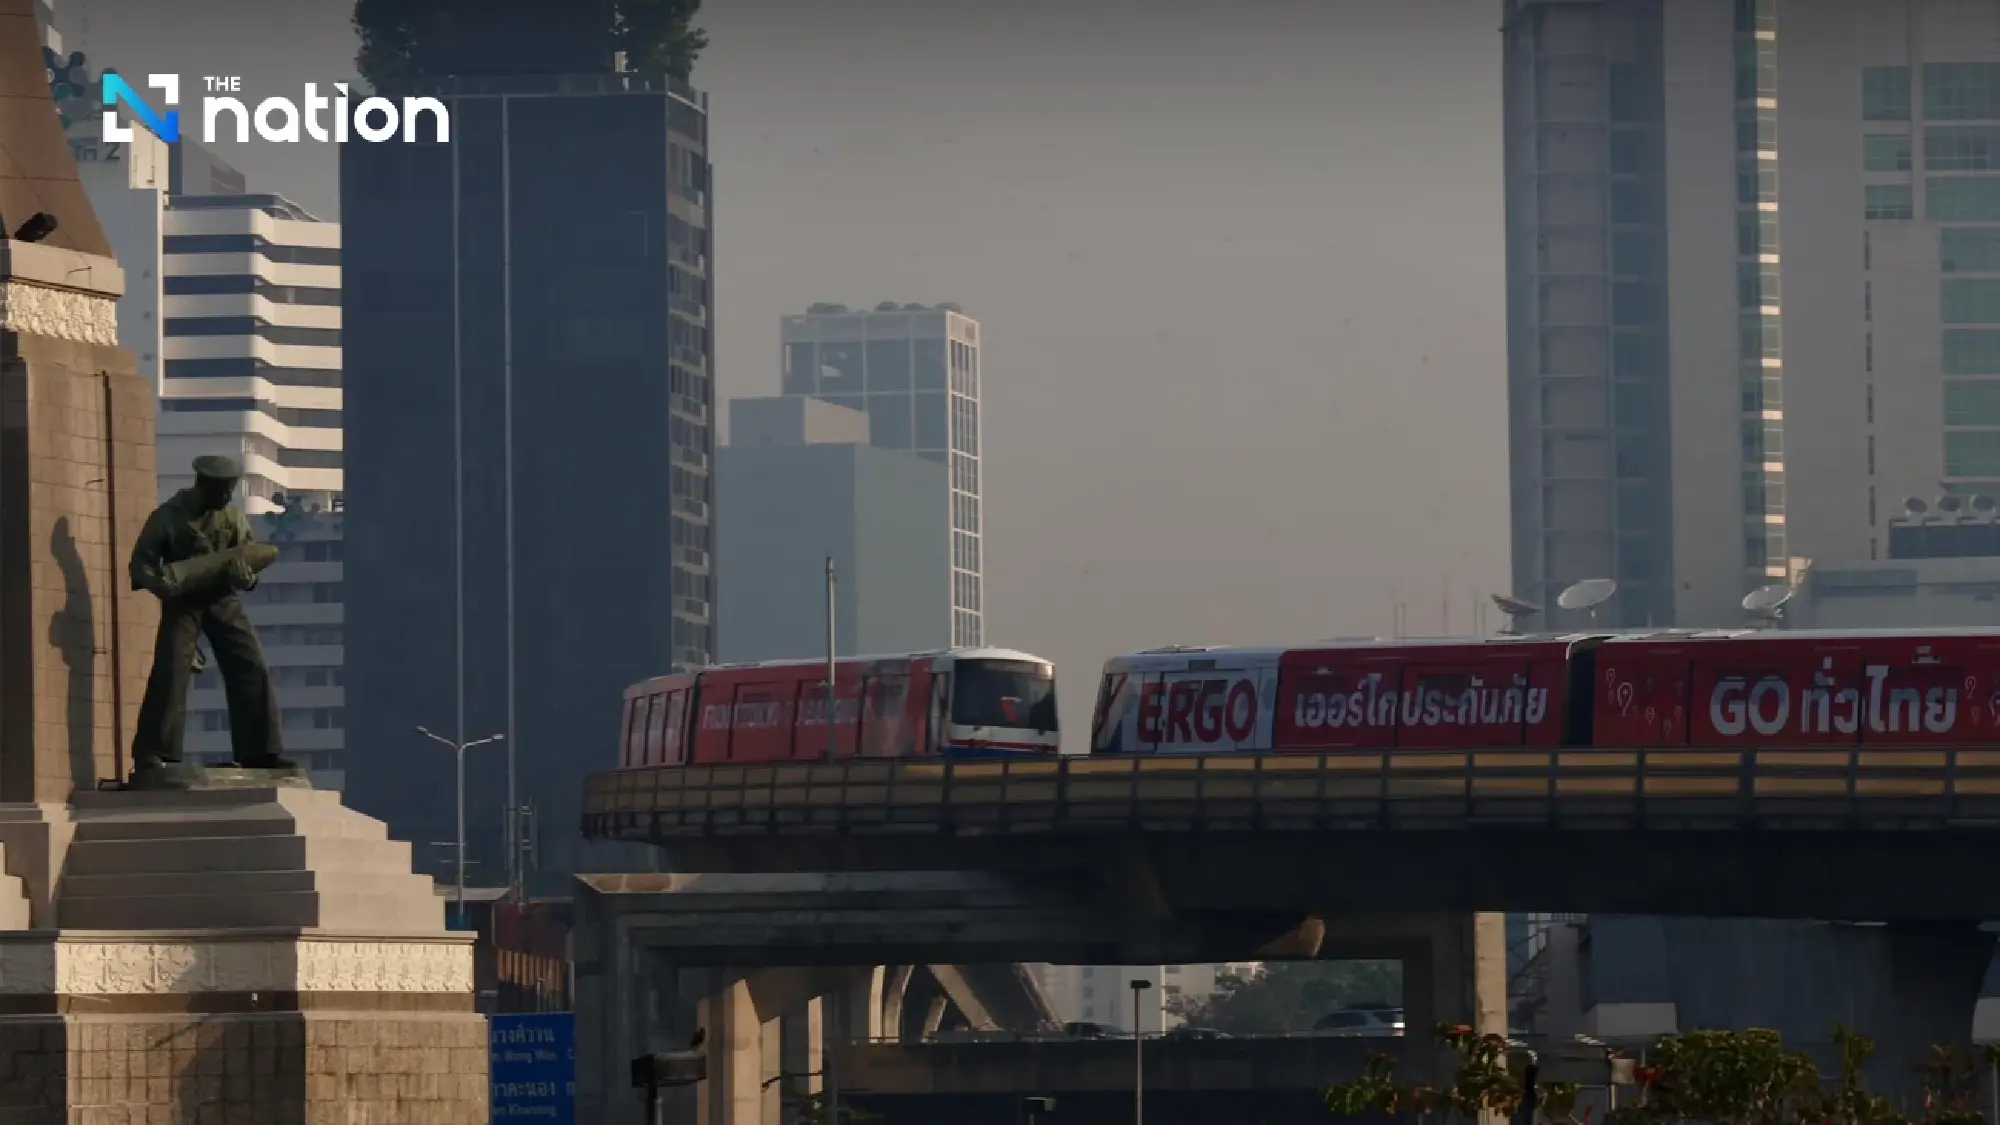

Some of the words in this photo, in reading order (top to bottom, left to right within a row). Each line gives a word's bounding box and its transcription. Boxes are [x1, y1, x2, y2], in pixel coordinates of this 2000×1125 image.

[1137, 678, 1257, 743] ERGO
[1294, 673, 1548, 727] เออร์โกประกันภัย
[1710, 675, 1790, 736] GO
[1801, 656, 1957, 734] ทั่วไทย
